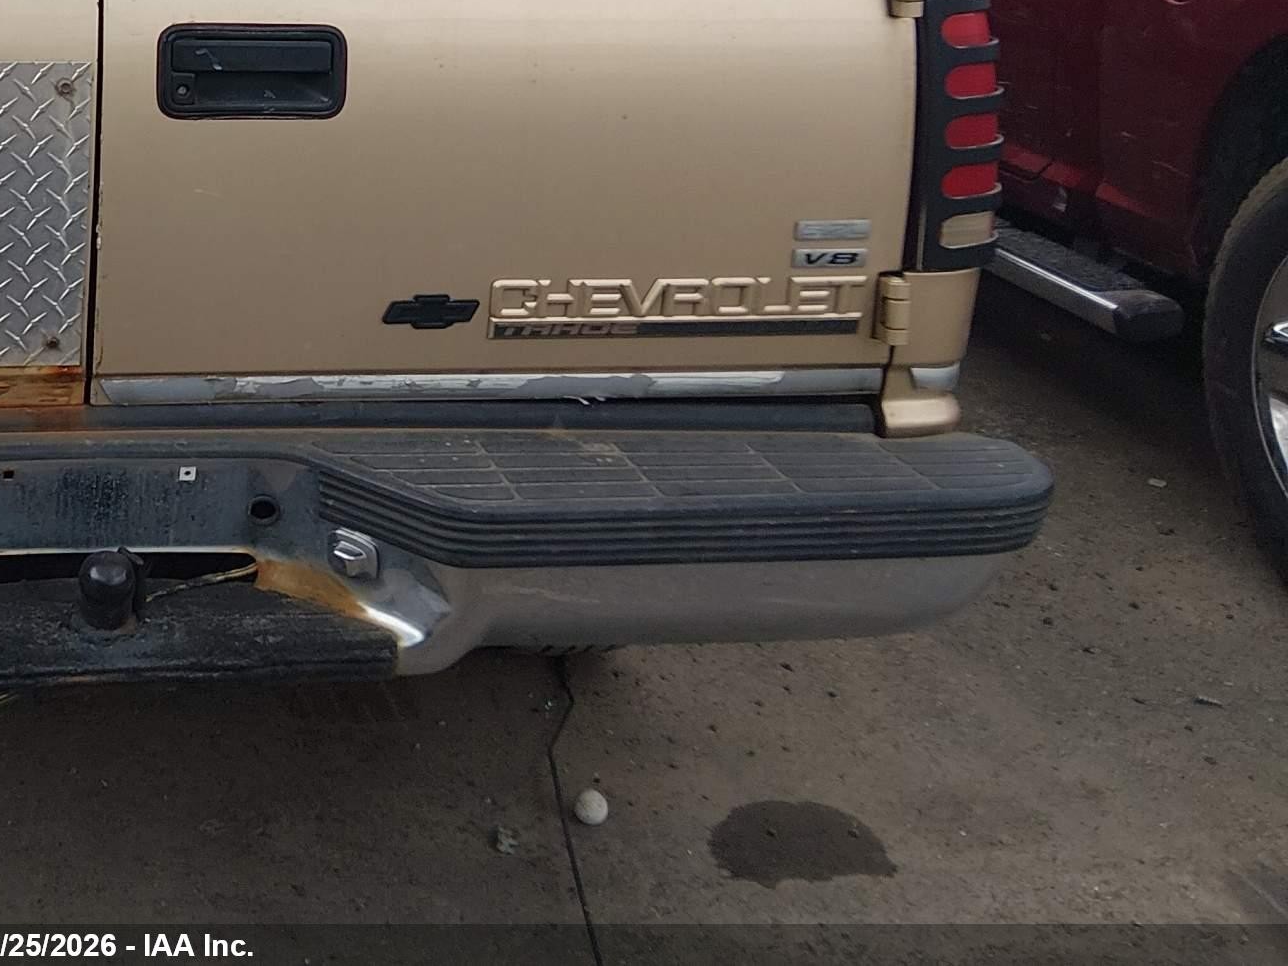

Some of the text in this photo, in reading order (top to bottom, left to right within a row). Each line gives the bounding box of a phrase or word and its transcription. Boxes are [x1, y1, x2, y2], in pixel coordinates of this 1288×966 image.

[805, 252, 859, 265] V8
[491, 276, 867, 318] CHEVROLET
[497, 322, 638, 336] TAHOE
